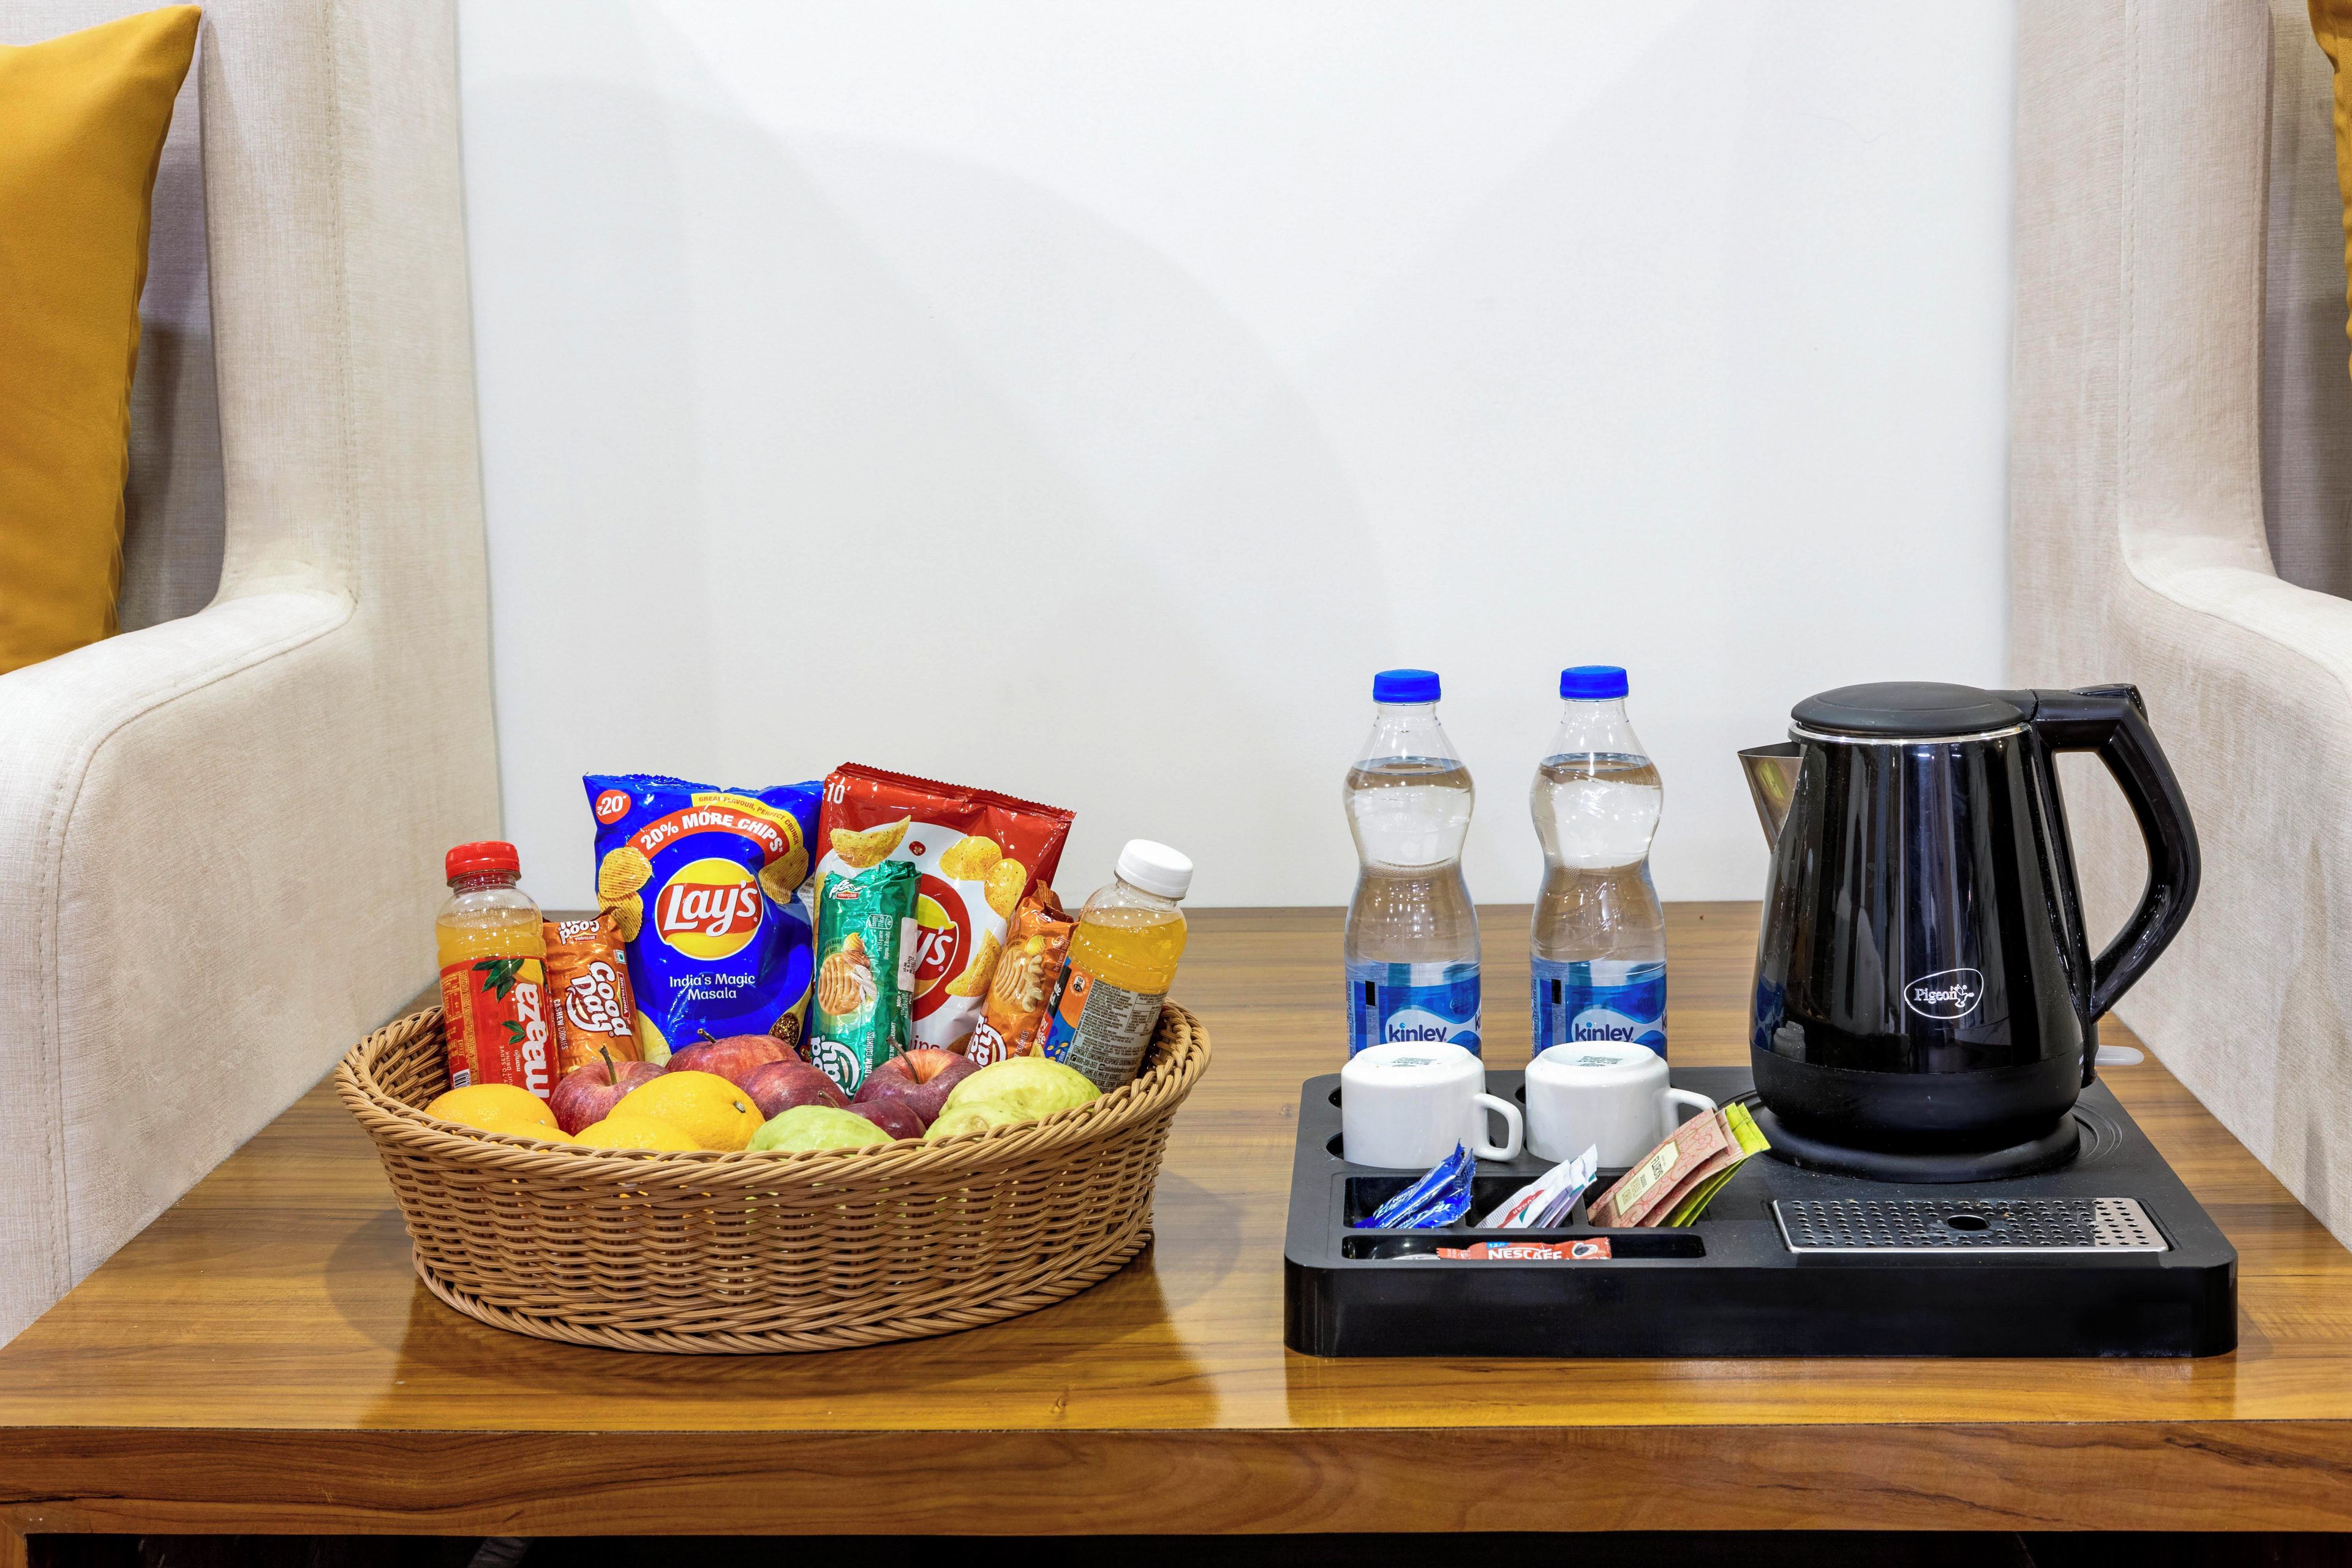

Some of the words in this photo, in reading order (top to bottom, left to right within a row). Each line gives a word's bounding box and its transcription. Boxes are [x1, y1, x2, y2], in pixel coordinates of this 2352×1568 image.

[640, 822, 679, 850] 20%
[682, 811, 734, 830] MORE
[737, 818, 782, 853] CHIPS
[756, 807, 785, 820] PERFECT
[785, 819, 799, 846] CRUNCH
[663, 880, 758, 937] Lay's
[915, 925, 954, 971] y's
[669, 974, 712, 988] India's
[715, 973, 755, 988] Magic
[566, 974, 612, 1031] Day
[590, 962, 632, 1036] Good
[620, 977, 628, 1014] BRITANNIA
[688, 987, 737, 1001] Masala
[1914, 988, 1958, 1004] Pigeon
[553, 998, 564, 1026] CASHEW
[515, 982, 550, 1098] maaza
[558, 1025, 568, 1050] COOKIES
[864, 1031, 875, 1057] COOKIES
[1017, 1030, 1030, 1054] COOKIES
[1389, 1023, 1447, 1041] kinley
[1575, 1022, 1634, 1041] kinley
[863, 1058, 873, 1078] ADAM
[1073, 1046, 1087, 1057] CONTACT
[1087, 1052, 1105, 1063] CONSUMER
[1104, 1057, 1120, 1065] RESPONSE
